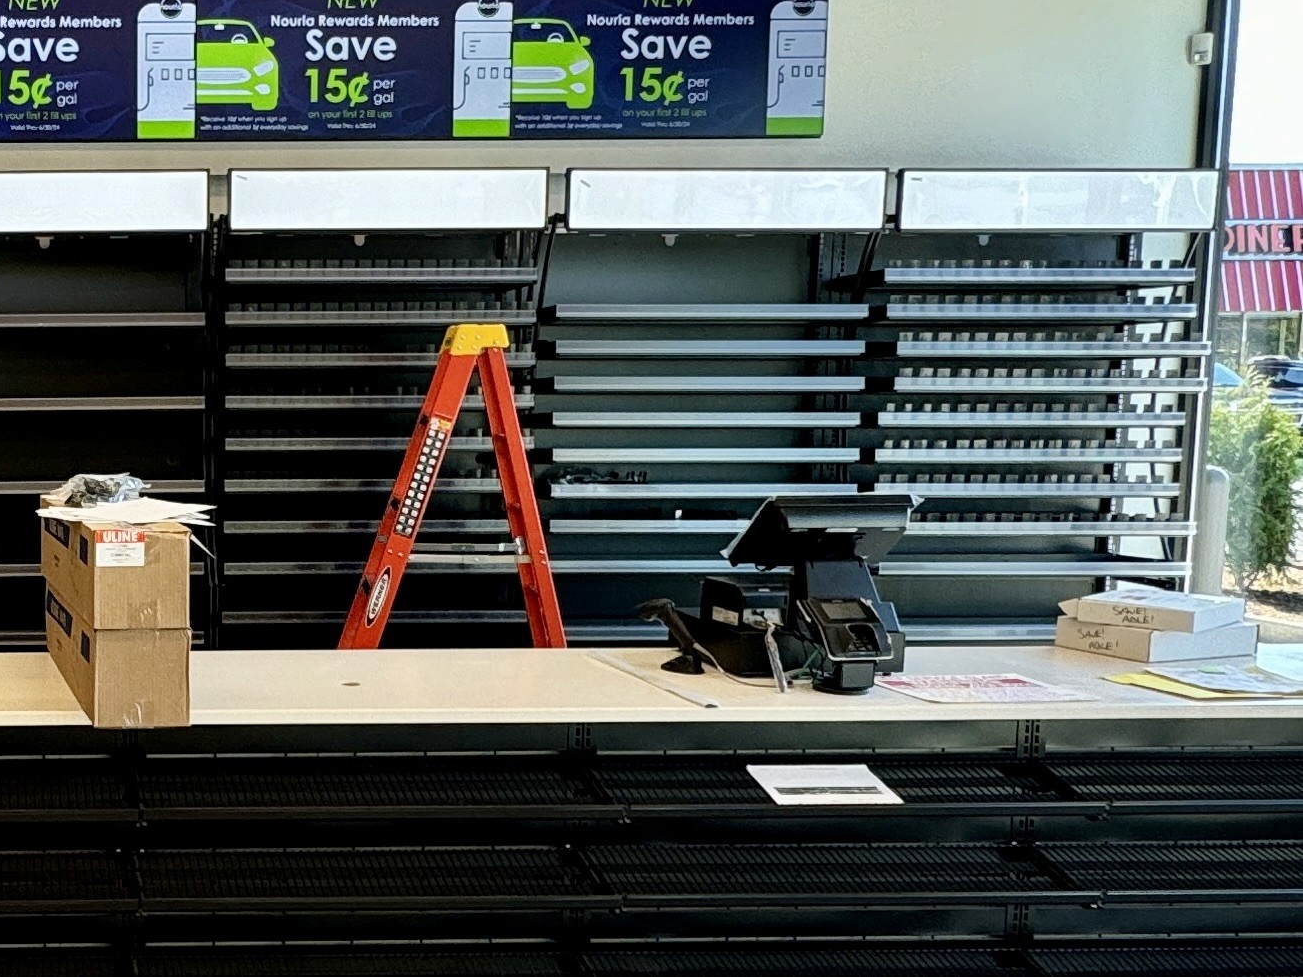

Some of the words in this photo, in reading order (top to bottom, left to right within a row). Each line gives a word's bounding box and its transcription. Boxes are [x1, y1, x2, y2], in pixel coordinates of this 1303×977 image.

[0, 16, 56, 28] Rewards
[59, 16, 121, 28] Members
[271, 15, 314, 27] Nouria
[318, 15, 374, 27] Rewards
[377, 14, 439, 27] Members
[587, 14, 631, 26] Nouria
[634, 13, 690, 26] Rewards
[693, 13, 754, 26] Members
[305, 29, 397, 61] Save
[621, 28, 712, 59] Save
[56, 80, 79, 91] per
[304, 68, 369, 106] 15¢
[373, 79, 395, 90] per
[619, 67, 684, 105] 15¢
[688, 77, 710, 88] per
[57, 95, 77, 107] gal
[374, 93, 394, 105] gal
[688, 92, 708, 104] gal
[5, 113, 24, 121] your
[26, 111, 41, 119] first
[50, 111, 59, 119] fill
[61, 113, 77, 121] ups
[322, 111, 341, 119] your
[343, 110, 357, 118] first
[359, 110, 364, 118] 2
[367, 110, 375, 118] fill
[377, 111, 393, 119] ups
[636, 110, 655, 118] your
[657, 108, 671, 116] first
[681, 108, 689, 116] fill
[691, 110, 707, 118] ups
[103, 530, 138, 543] ULINE
[371, 577, 387, 615] WERNER
